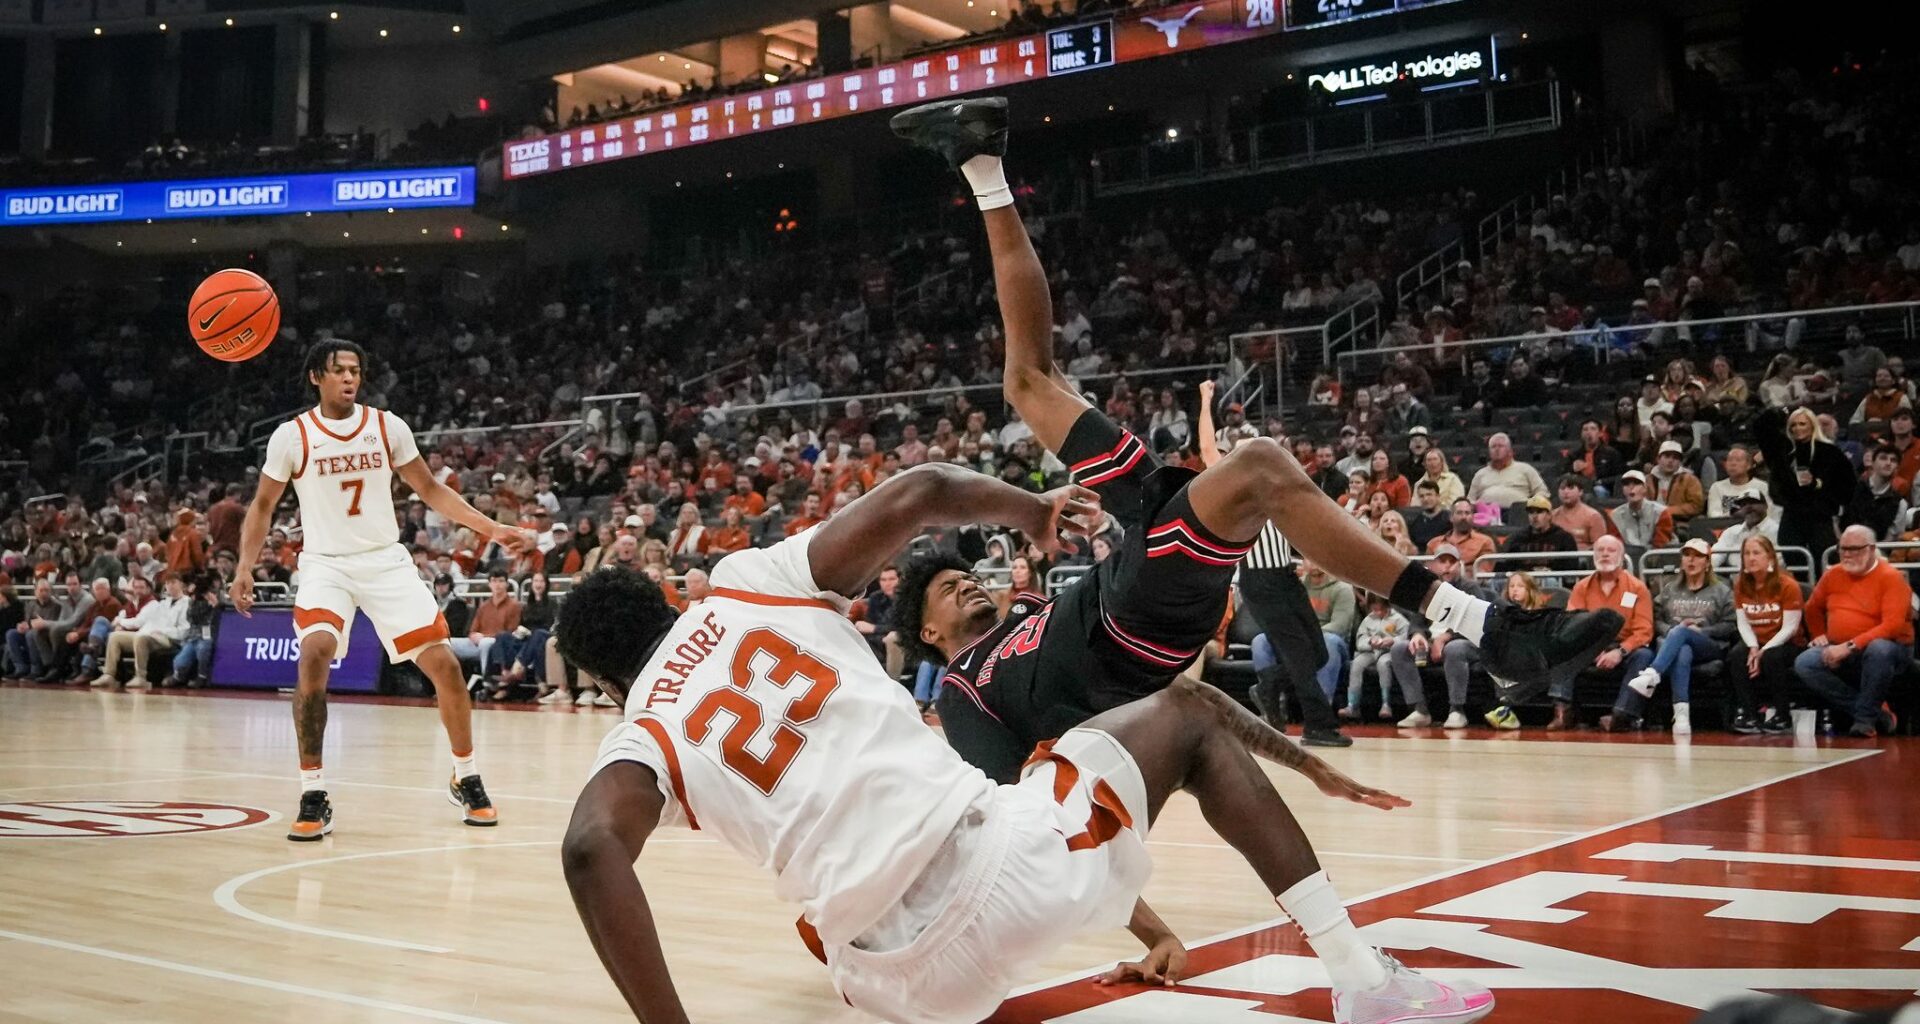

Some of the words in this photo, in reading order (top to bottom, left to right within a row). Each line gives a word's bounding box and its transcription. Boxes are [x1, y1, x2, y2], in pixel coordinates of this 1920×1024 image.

[1246, 0, 1275, 28] 28
[1052, 33, 1074, 49] TOL:
[1092, 26, 1101, 43] 3
[1052, 50, 1087, 70] FOULS:
[1093, 46, 1101, 63] 7
[509, 139, 549, 163] TEXAS
[724, 100, 735, 116] FT
[912, 60, 929, 79] AST
[946, 55, 959, 71] TO
[980, 47, 998, 65] BLK
[1019, 39, 1035, 57] STL
[728, 118, 735, 134] 1
[752, 113, 761, 130] 2
[881, 87, 894, 105] 12
[986, 67, 995, 84] 2
[1025, 60, 1034, 77] 4
[169, 188, 217, 208] BUD
[218, 185, 284, 206] LIGHT
[337, 181, 387, 201] BUD
[387, 178, 457, 199] LIGHT
[9, 196, 54, 216] BUD
[55, 193, 119, 213] LIGHT
[210, 327, 256, 354] ELITE
[314, 452, 383, 477] TEXAS
[340, 478, 364, 517] 7
[1741, 602, 1781, 614] TEXAS
[1000, 602, 1054, 659] 2
[244, 637, 301, 662] TRUIS
[646, 611, 726, 708] TRAORE
[682, 626, 841, 797] 23
